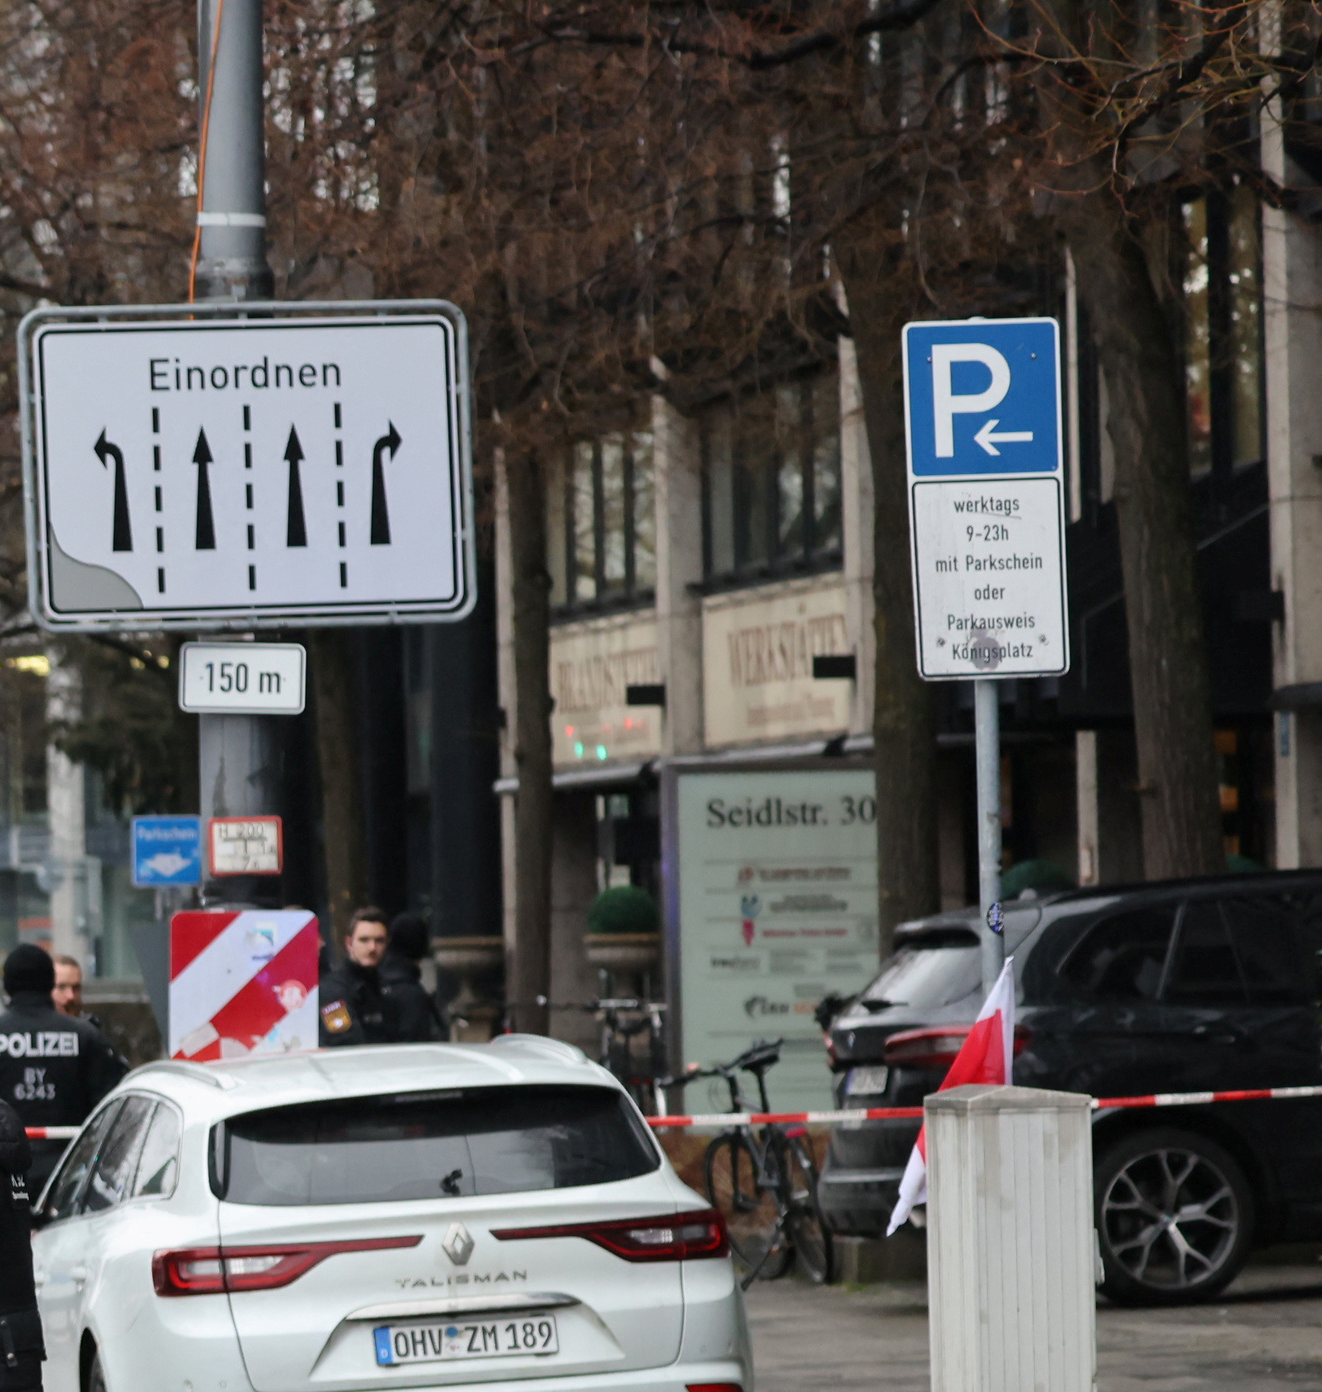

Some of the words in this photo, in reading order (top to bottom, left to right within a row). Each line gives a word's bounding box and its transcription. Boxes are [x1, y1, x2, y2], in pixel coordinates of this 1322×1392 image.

[149, 355, 342, 391] Einordnen
[931, 342, 1011, 458] P
[953, 496, 1020, 516] werktags
[966, 523, 1009, 542] 9-23h
[935, 554, 959, 572] mit
[965, 552, 1043, 571] Parkschein
[974, 583, 1006, 601] oder
[947, 611, 1036, 631] Parkausweis
[952, 641, 1034, 663] Königsplatz
[204, 662, 248, 693] 150
[259, 671, 281, 693] m
[706, 795, 828, 828] Seidlstr.
[839, 795, 877, 827] 30
[24, 1067, 47, 1085] BY
[395, 1270, 528, 1289] TALISMAN
[394, 1328, 444, 1358] OHV
[464, 1325, 499, 1353] ZM
[505, 1321, 553, 1351] 189
